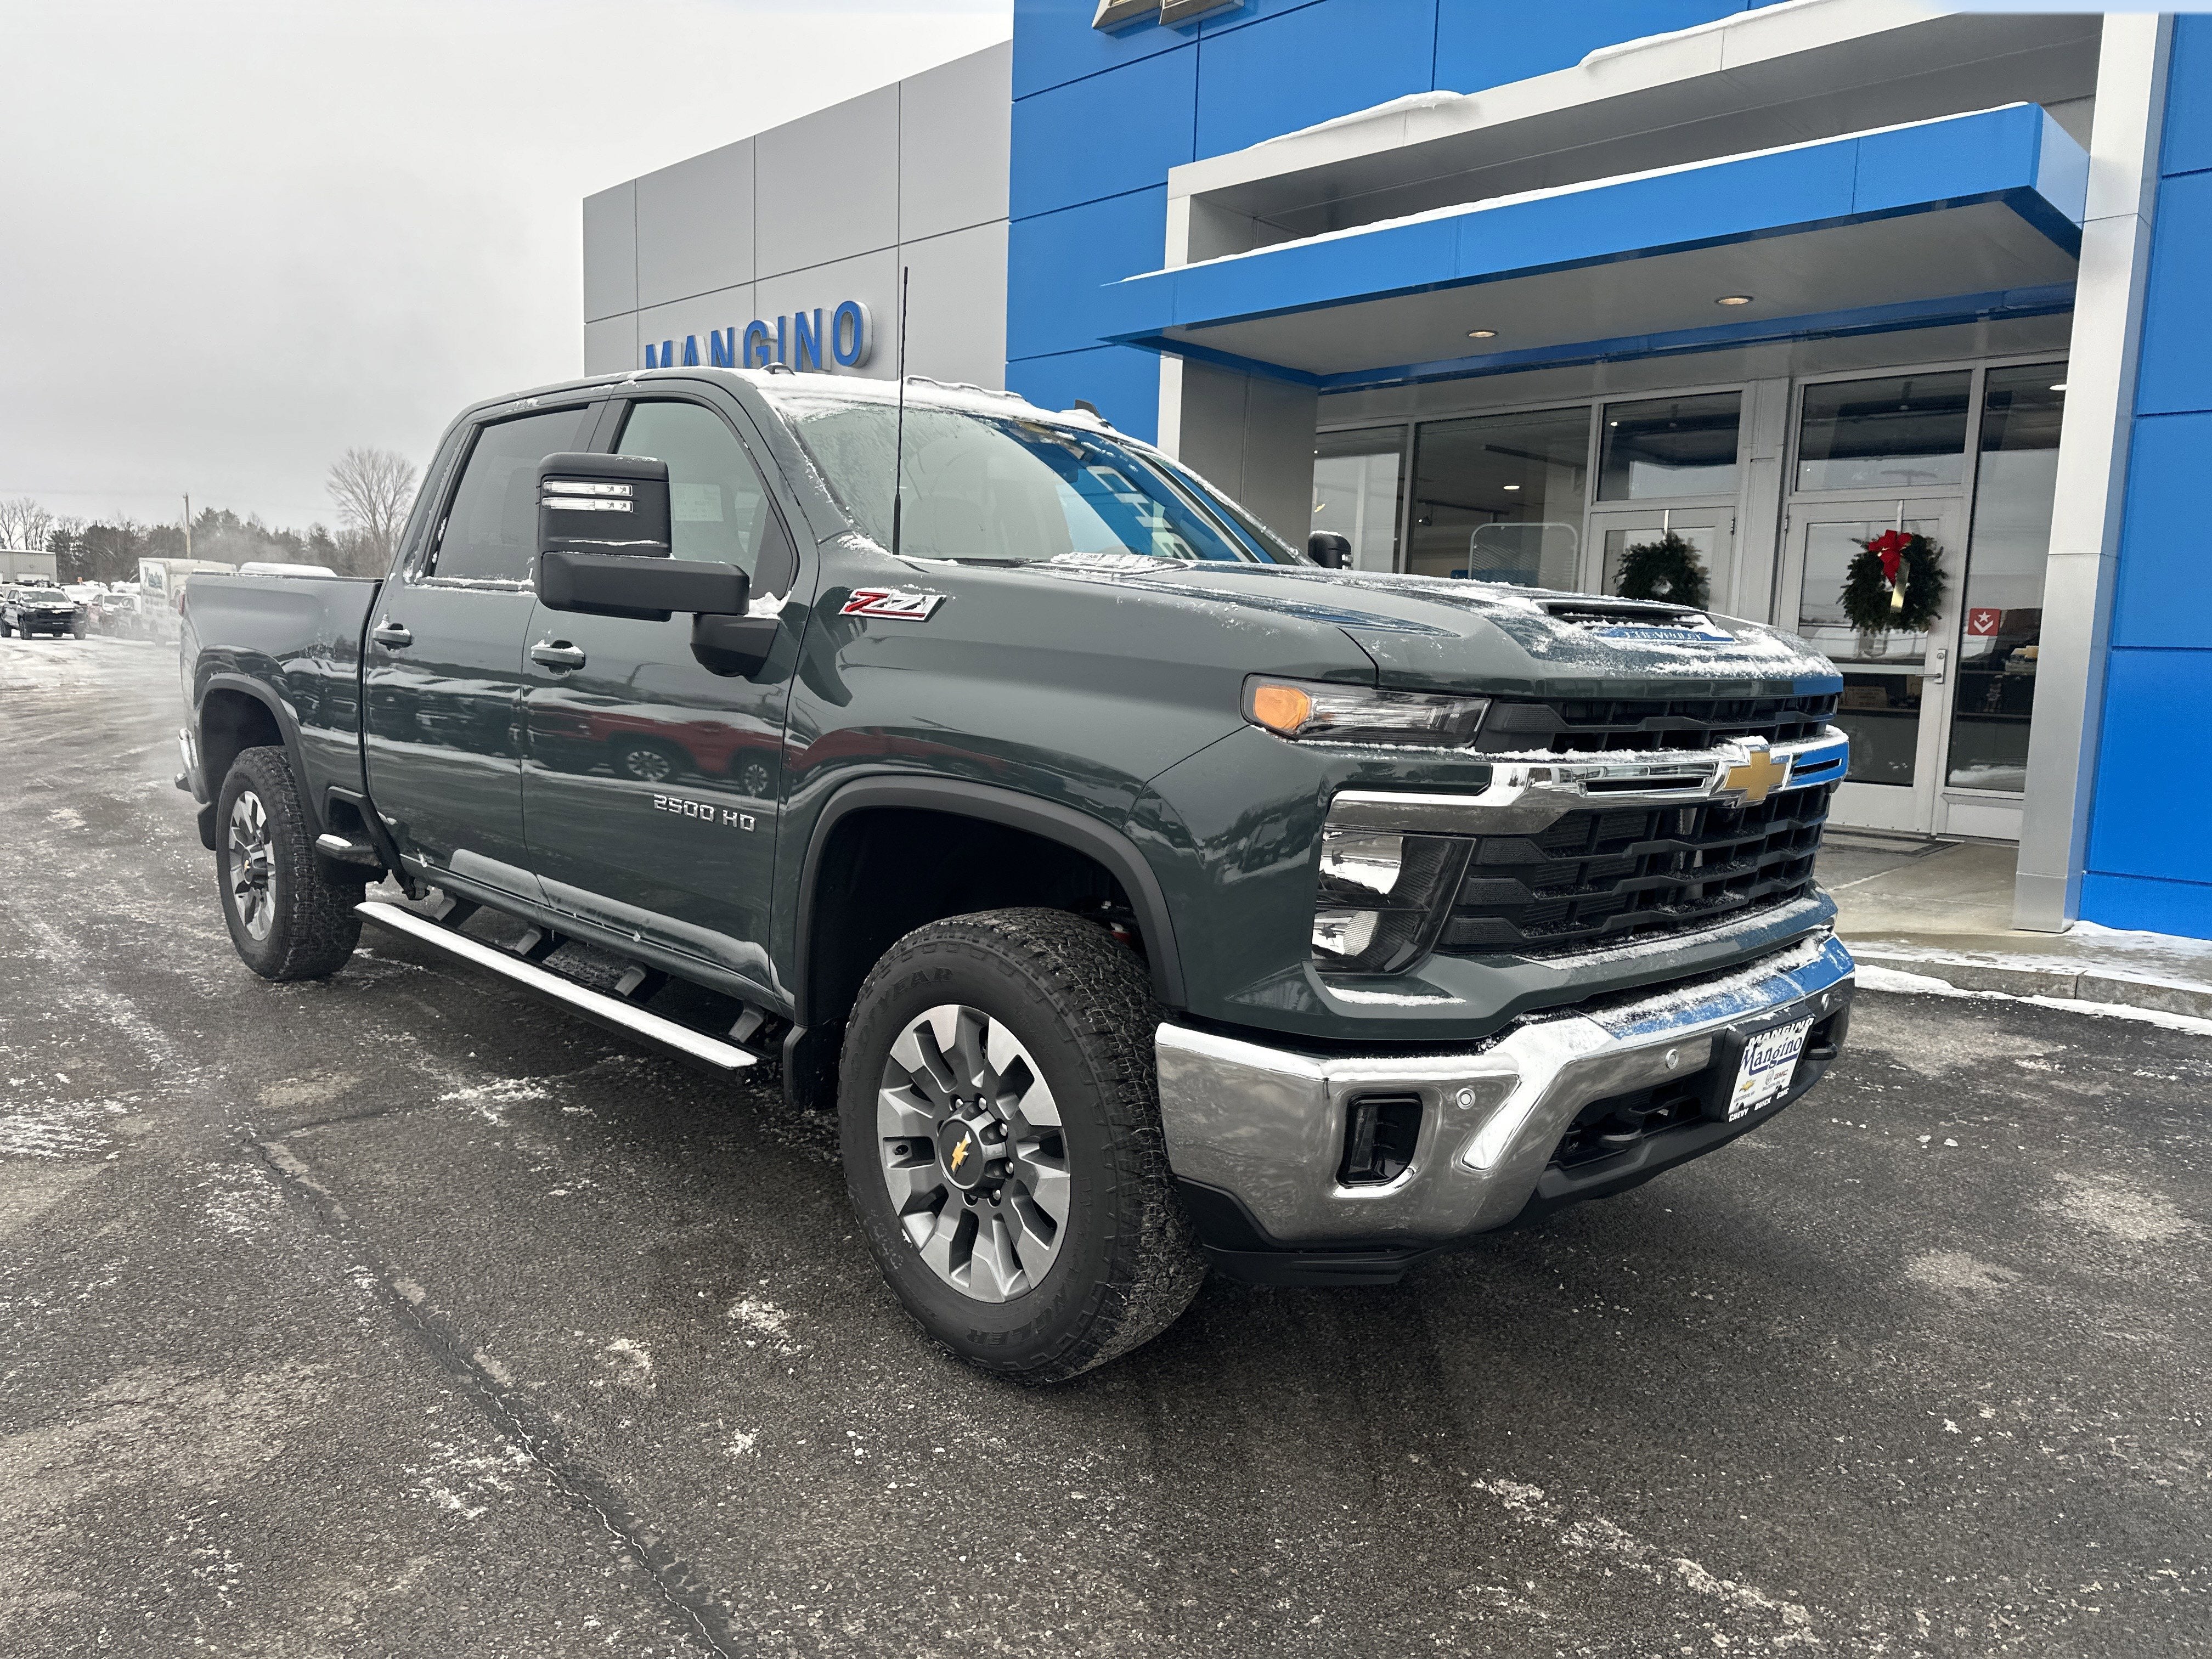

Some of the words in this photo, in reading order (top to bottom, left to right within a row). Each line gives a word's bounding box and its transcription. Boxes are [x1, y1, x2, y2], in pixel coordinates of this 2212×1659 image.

[645, 300, 872, 370] MANGINO
[839, 588, 947, 622] Z71
[653, 794, 715, 822] 2500
[723, 809, 756, 832] HD
[1748, 1018, 1814, 1047] MANGINO
[1741, 1037, 1803, 1071] Mangino
[1729, 1107, 1749, 1122] CHEVY
[1754, 1096, 1772, 1111] BUICK
